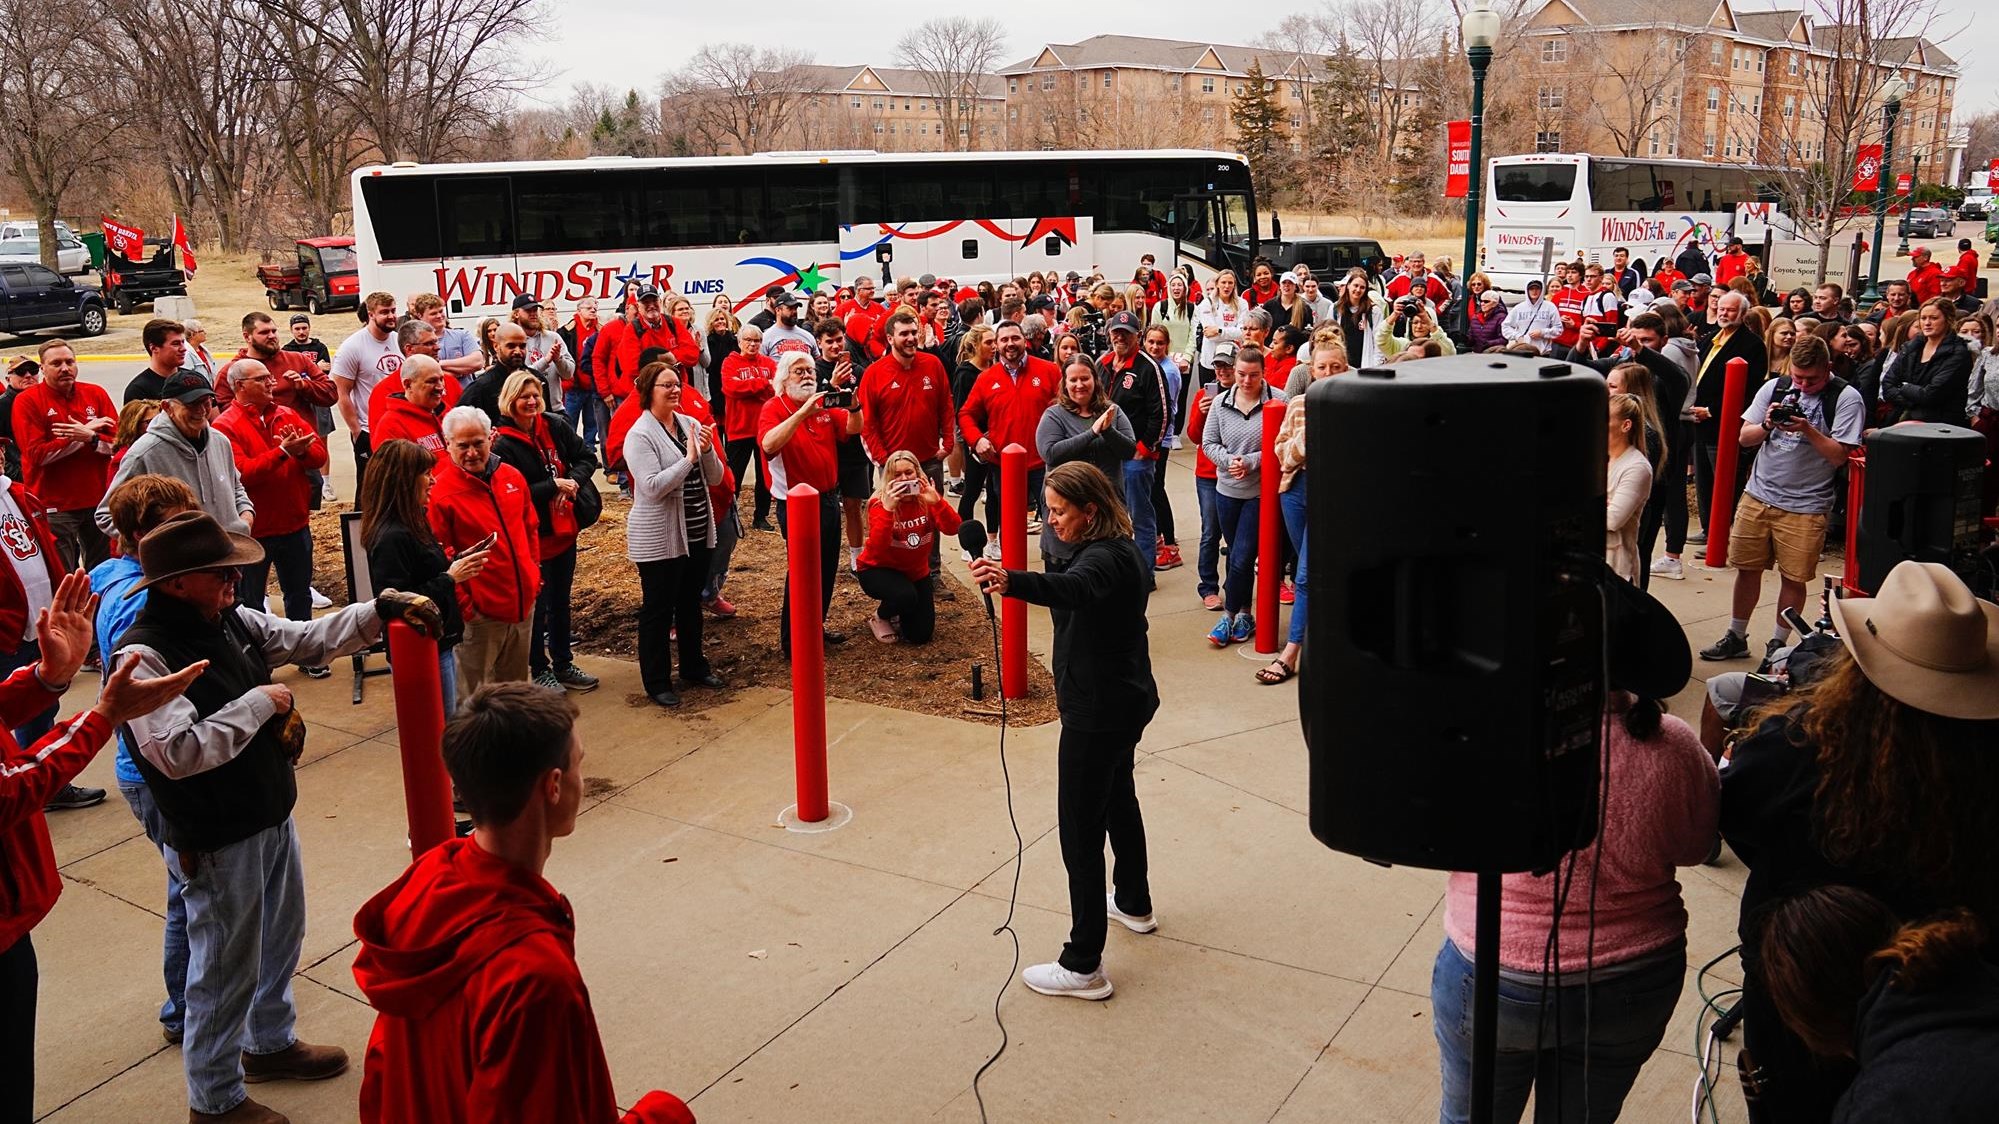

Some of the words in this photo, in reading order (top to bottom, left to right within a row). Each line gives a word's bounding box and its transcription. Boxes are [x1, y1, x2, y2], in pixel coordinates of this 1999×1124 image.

[1773, 266, 1796, 275] Coyote
[684, 279, 724, 295] LINES
[893, 515, 929, 530] CYOTE
